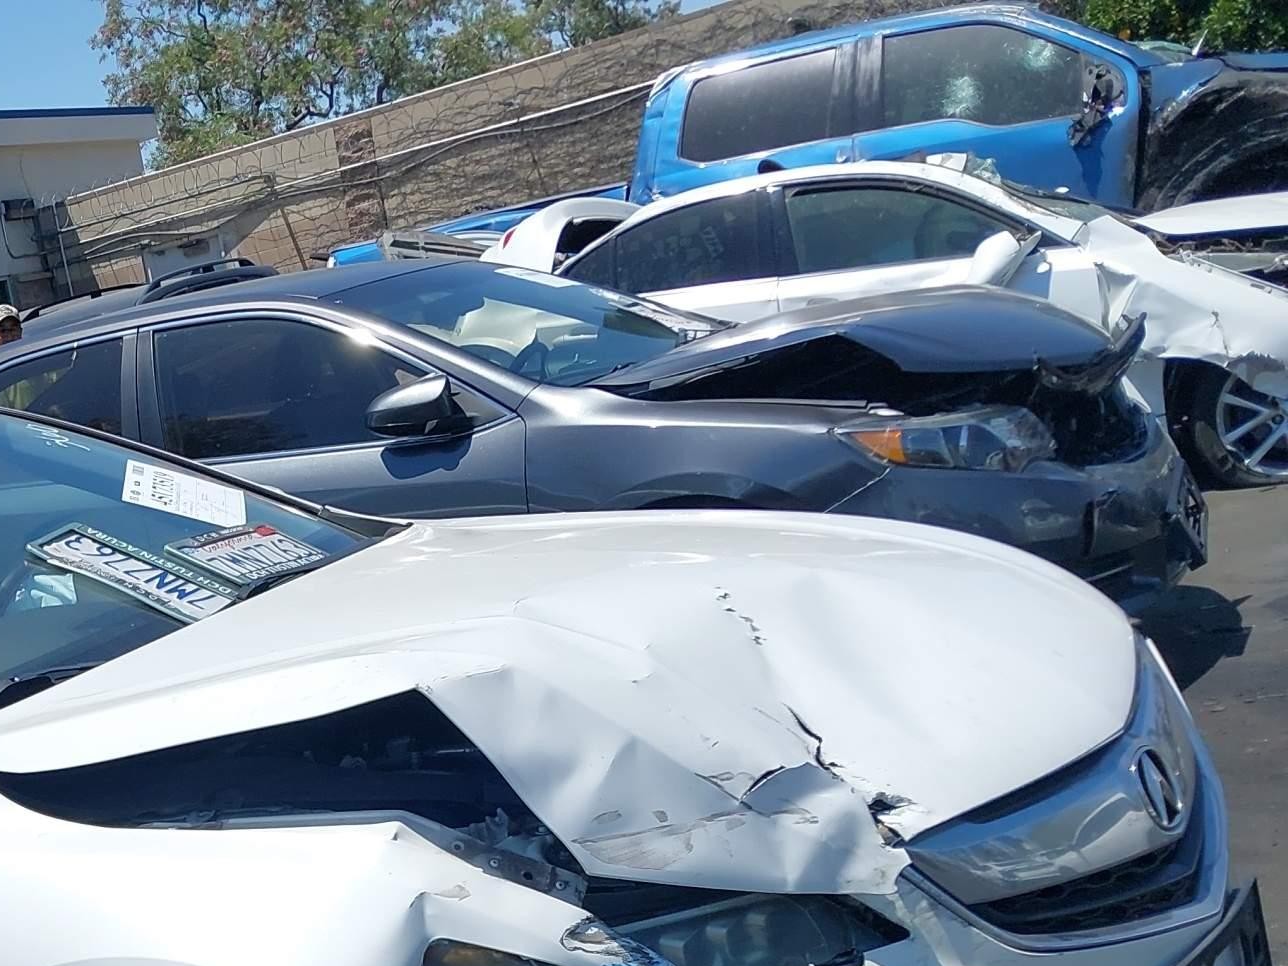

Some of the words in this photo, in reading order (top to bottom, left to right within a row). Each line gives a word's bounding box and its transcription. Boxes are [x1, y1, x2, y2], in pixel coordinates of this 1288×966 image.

[87, 527, 139, 553] ACURA
[139, 550, 197, 579] TUSTIN
[197, 575, 233, 594] DCH
